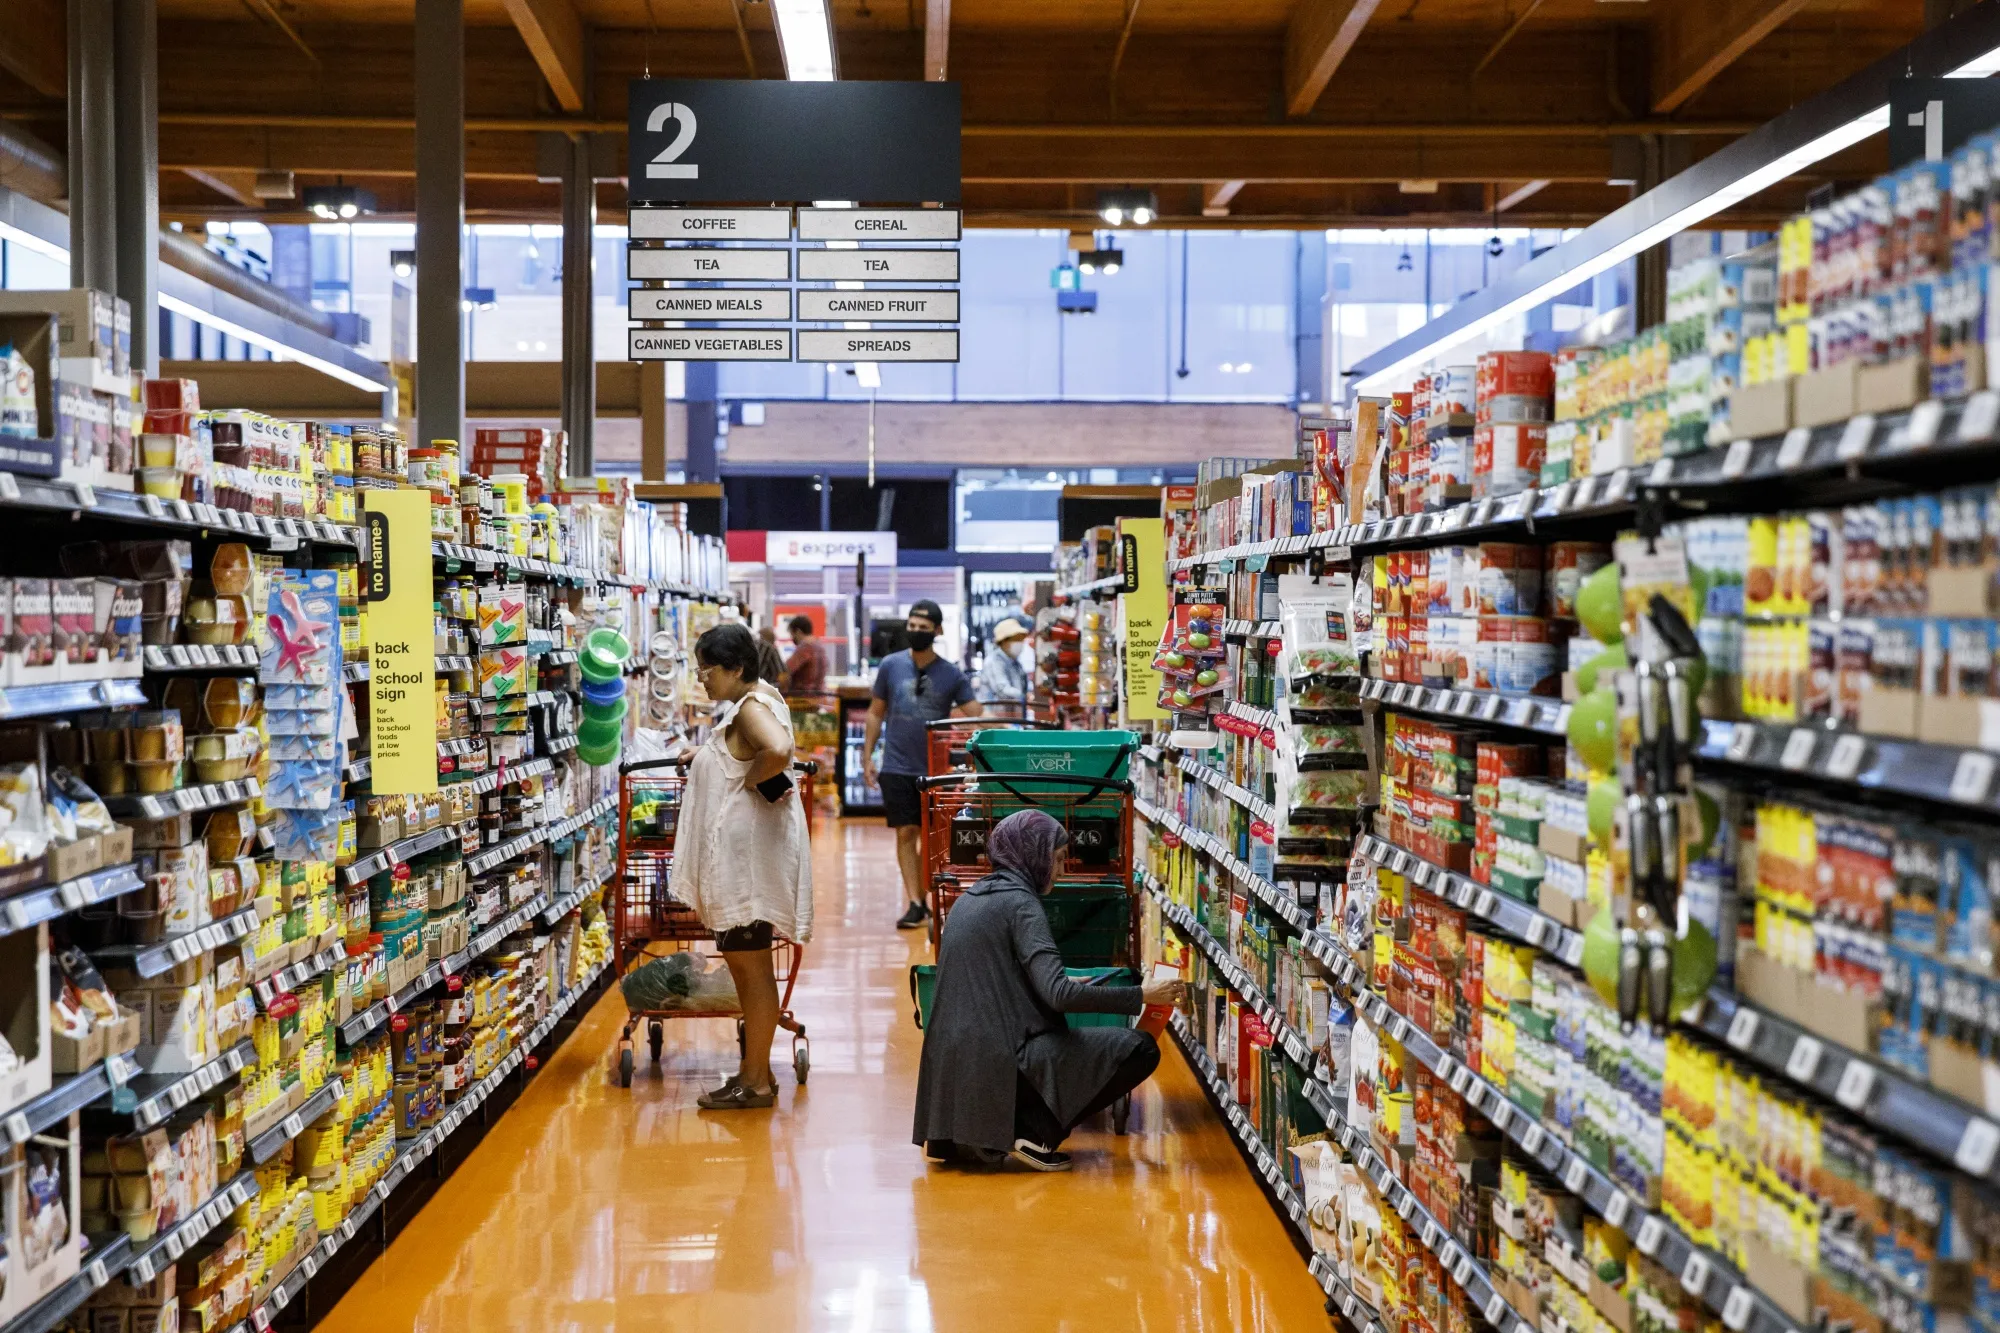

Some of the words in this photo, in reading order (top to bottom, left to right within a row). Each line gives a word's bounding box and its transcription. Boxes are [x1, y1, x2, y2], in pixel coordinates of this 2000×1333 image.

[1908, 100, 1943, 162] 1
[646, 102, 698, 178] 2
[682, 218, 736, 230] COFFEE
[854, 219, 908, 231] CEREAL
[694, 259, 720, 270] TEA
[864, 260, 890, 271] TEA
[656, 299, 712, 310] CANNED
[716, 299, 762, 311] MEALS
[828, 300, 884, 312] CANNED
[888, 300, 927, 312] FRUIT
[634, 338, 690, 350] CANNED
[694, 339, 783, 351] VEGETABLES
[848, 340, 911, 352] SPREADS
[802, 543, 876, 558] express
[373, 572, 384, 592] no
[1127, 573, 1134, 587] no
[1129, 619, 1152, 628] back
[1130, 629, 1139, 638] to
[375, 642, 410, 654] back
[1131, 650, 1150, 659] sign
[375, 658, 389, 669] to
[376, 672, 423, 684] school
[376, 688, 405, 702] sign
